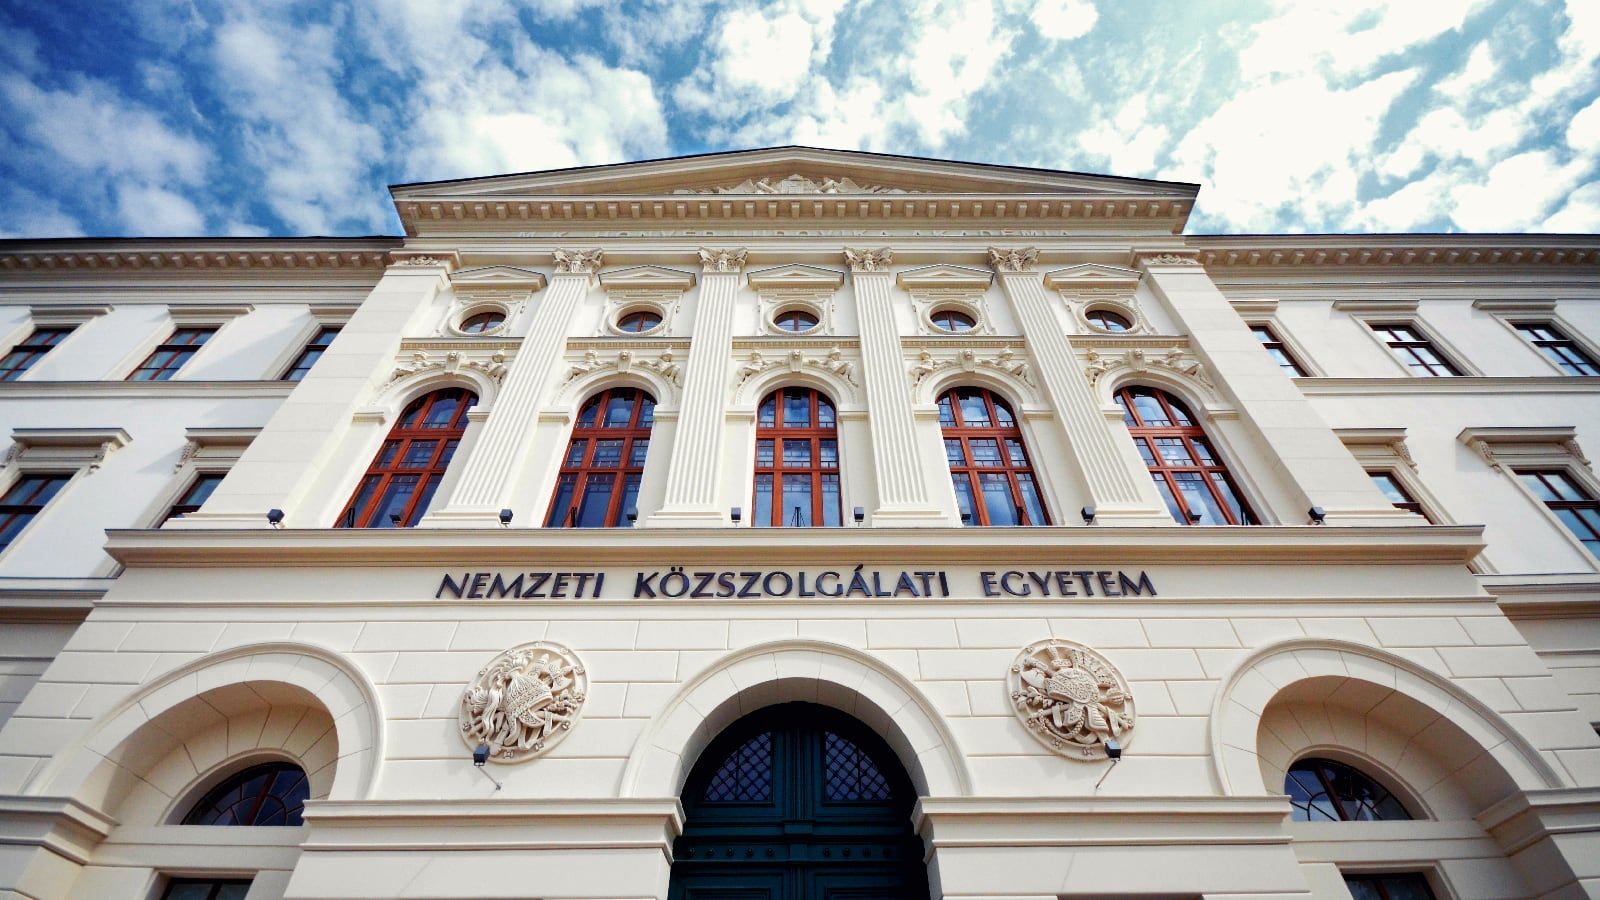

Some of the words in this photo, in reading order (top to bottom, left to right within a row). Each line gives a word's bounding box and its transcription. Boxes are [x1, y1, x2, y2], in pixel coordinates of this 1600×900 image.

[435, 572, 605, 599] NEMZETI
[633, 564, 950, 598] KÖZSZOLGÁLATI
[980, 571, 1158, 597] EGYETEM
